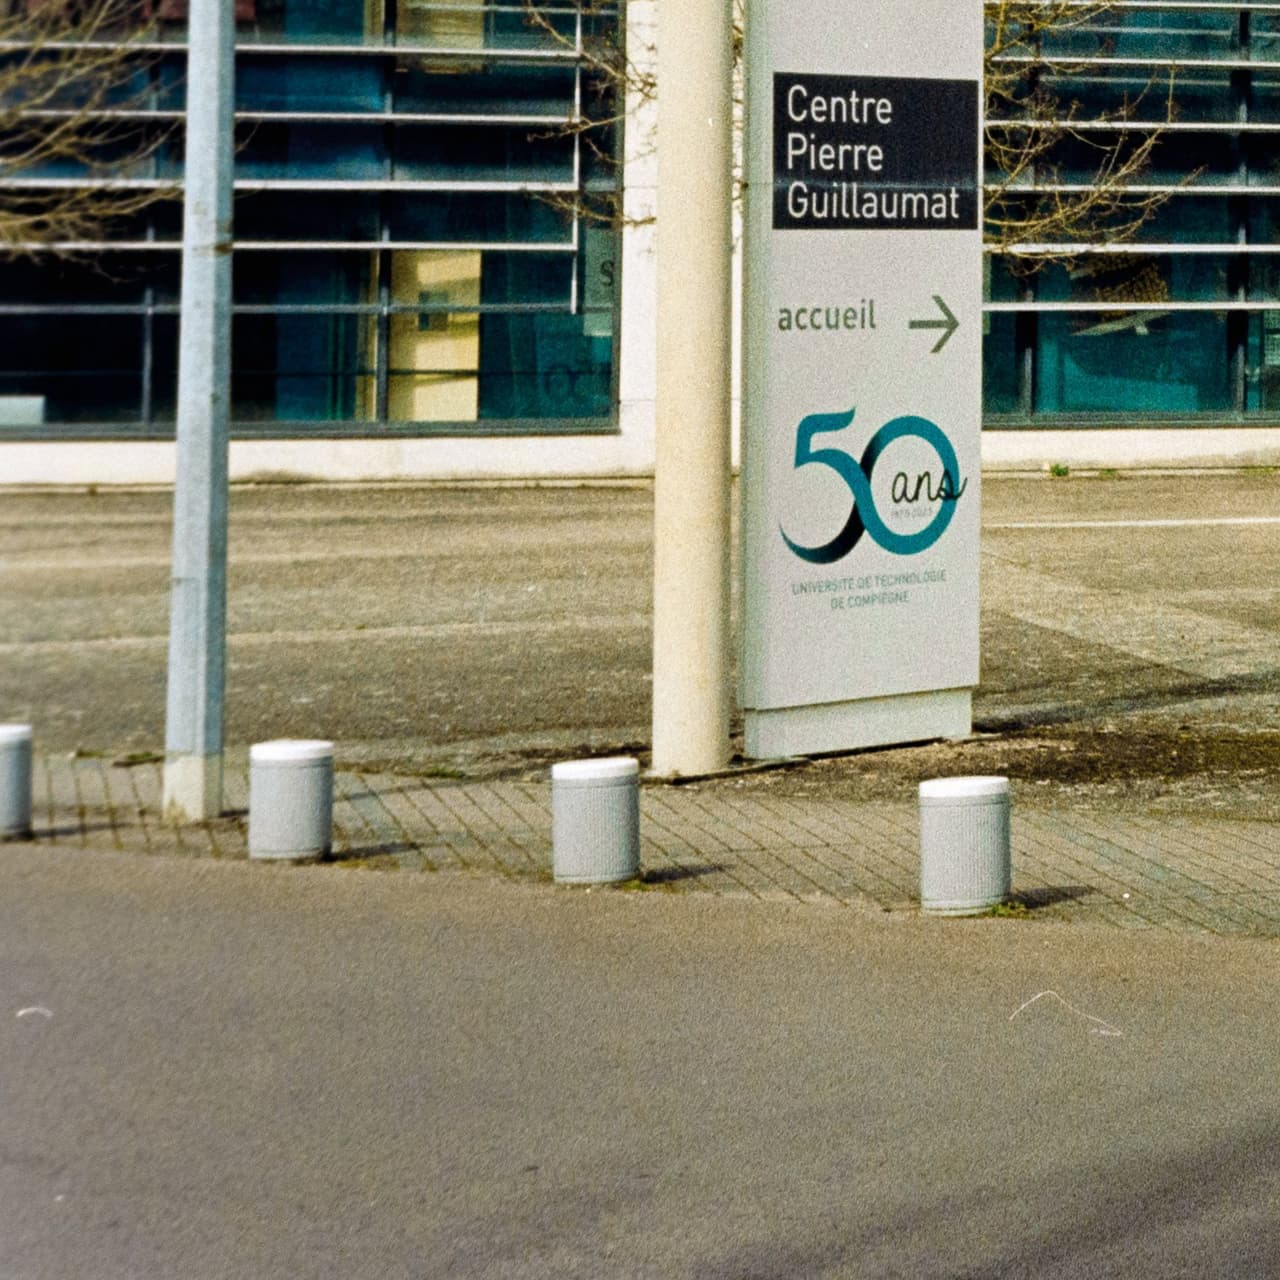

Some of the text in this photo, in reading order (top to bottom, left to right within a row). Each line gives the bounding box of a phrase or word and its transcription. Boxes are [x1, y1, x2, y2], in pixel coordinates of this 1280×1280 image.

[787, 84, 893, 124] Centre
[787, 132, 884, 171] Pierre
[787, 181, 960, 219] Guillaumat
[777, 298, 877, 331] accueil
[778, 406, 968, 564] 50 ans
[857, 575, 872, 590] DE
[875, 569, 947, 587] TECHNOLOGIE
[831, 596, 845, 610] DE
